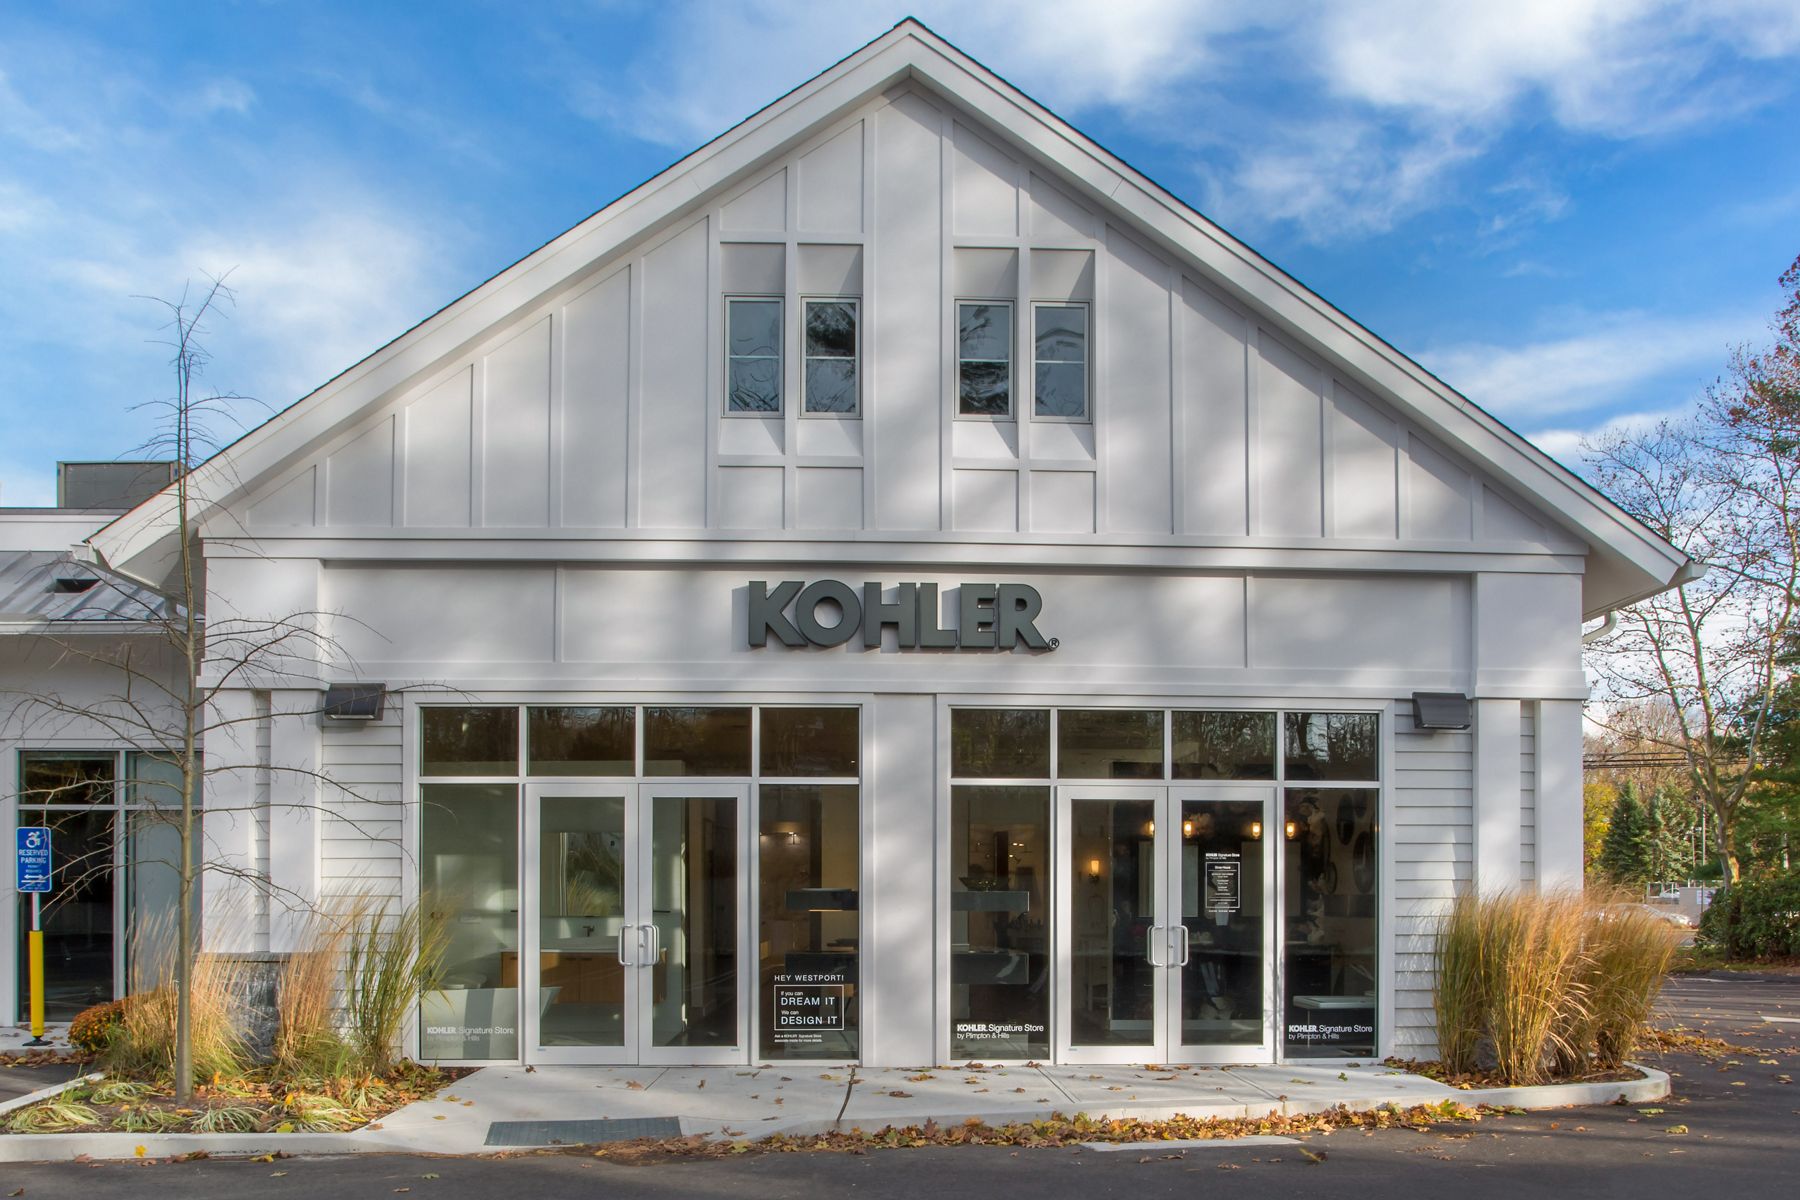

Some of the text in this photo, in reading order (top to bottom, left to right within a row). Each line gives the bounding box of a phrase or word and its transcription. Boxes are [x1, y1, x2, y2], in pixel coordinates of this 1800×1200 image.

[774, 974, 792, 982] HEY
[780, 997, 835, 1006] DREAM IT
[780, 1016, 838, 1024] DESIGN IT
[426, 1026, 515, 1036] KOHLER Signature Store
[956, 1024, 1044, 1033] KOHLER Signature Store
[1288, 1025, 1373, 1033] KOHLER Signature Store
